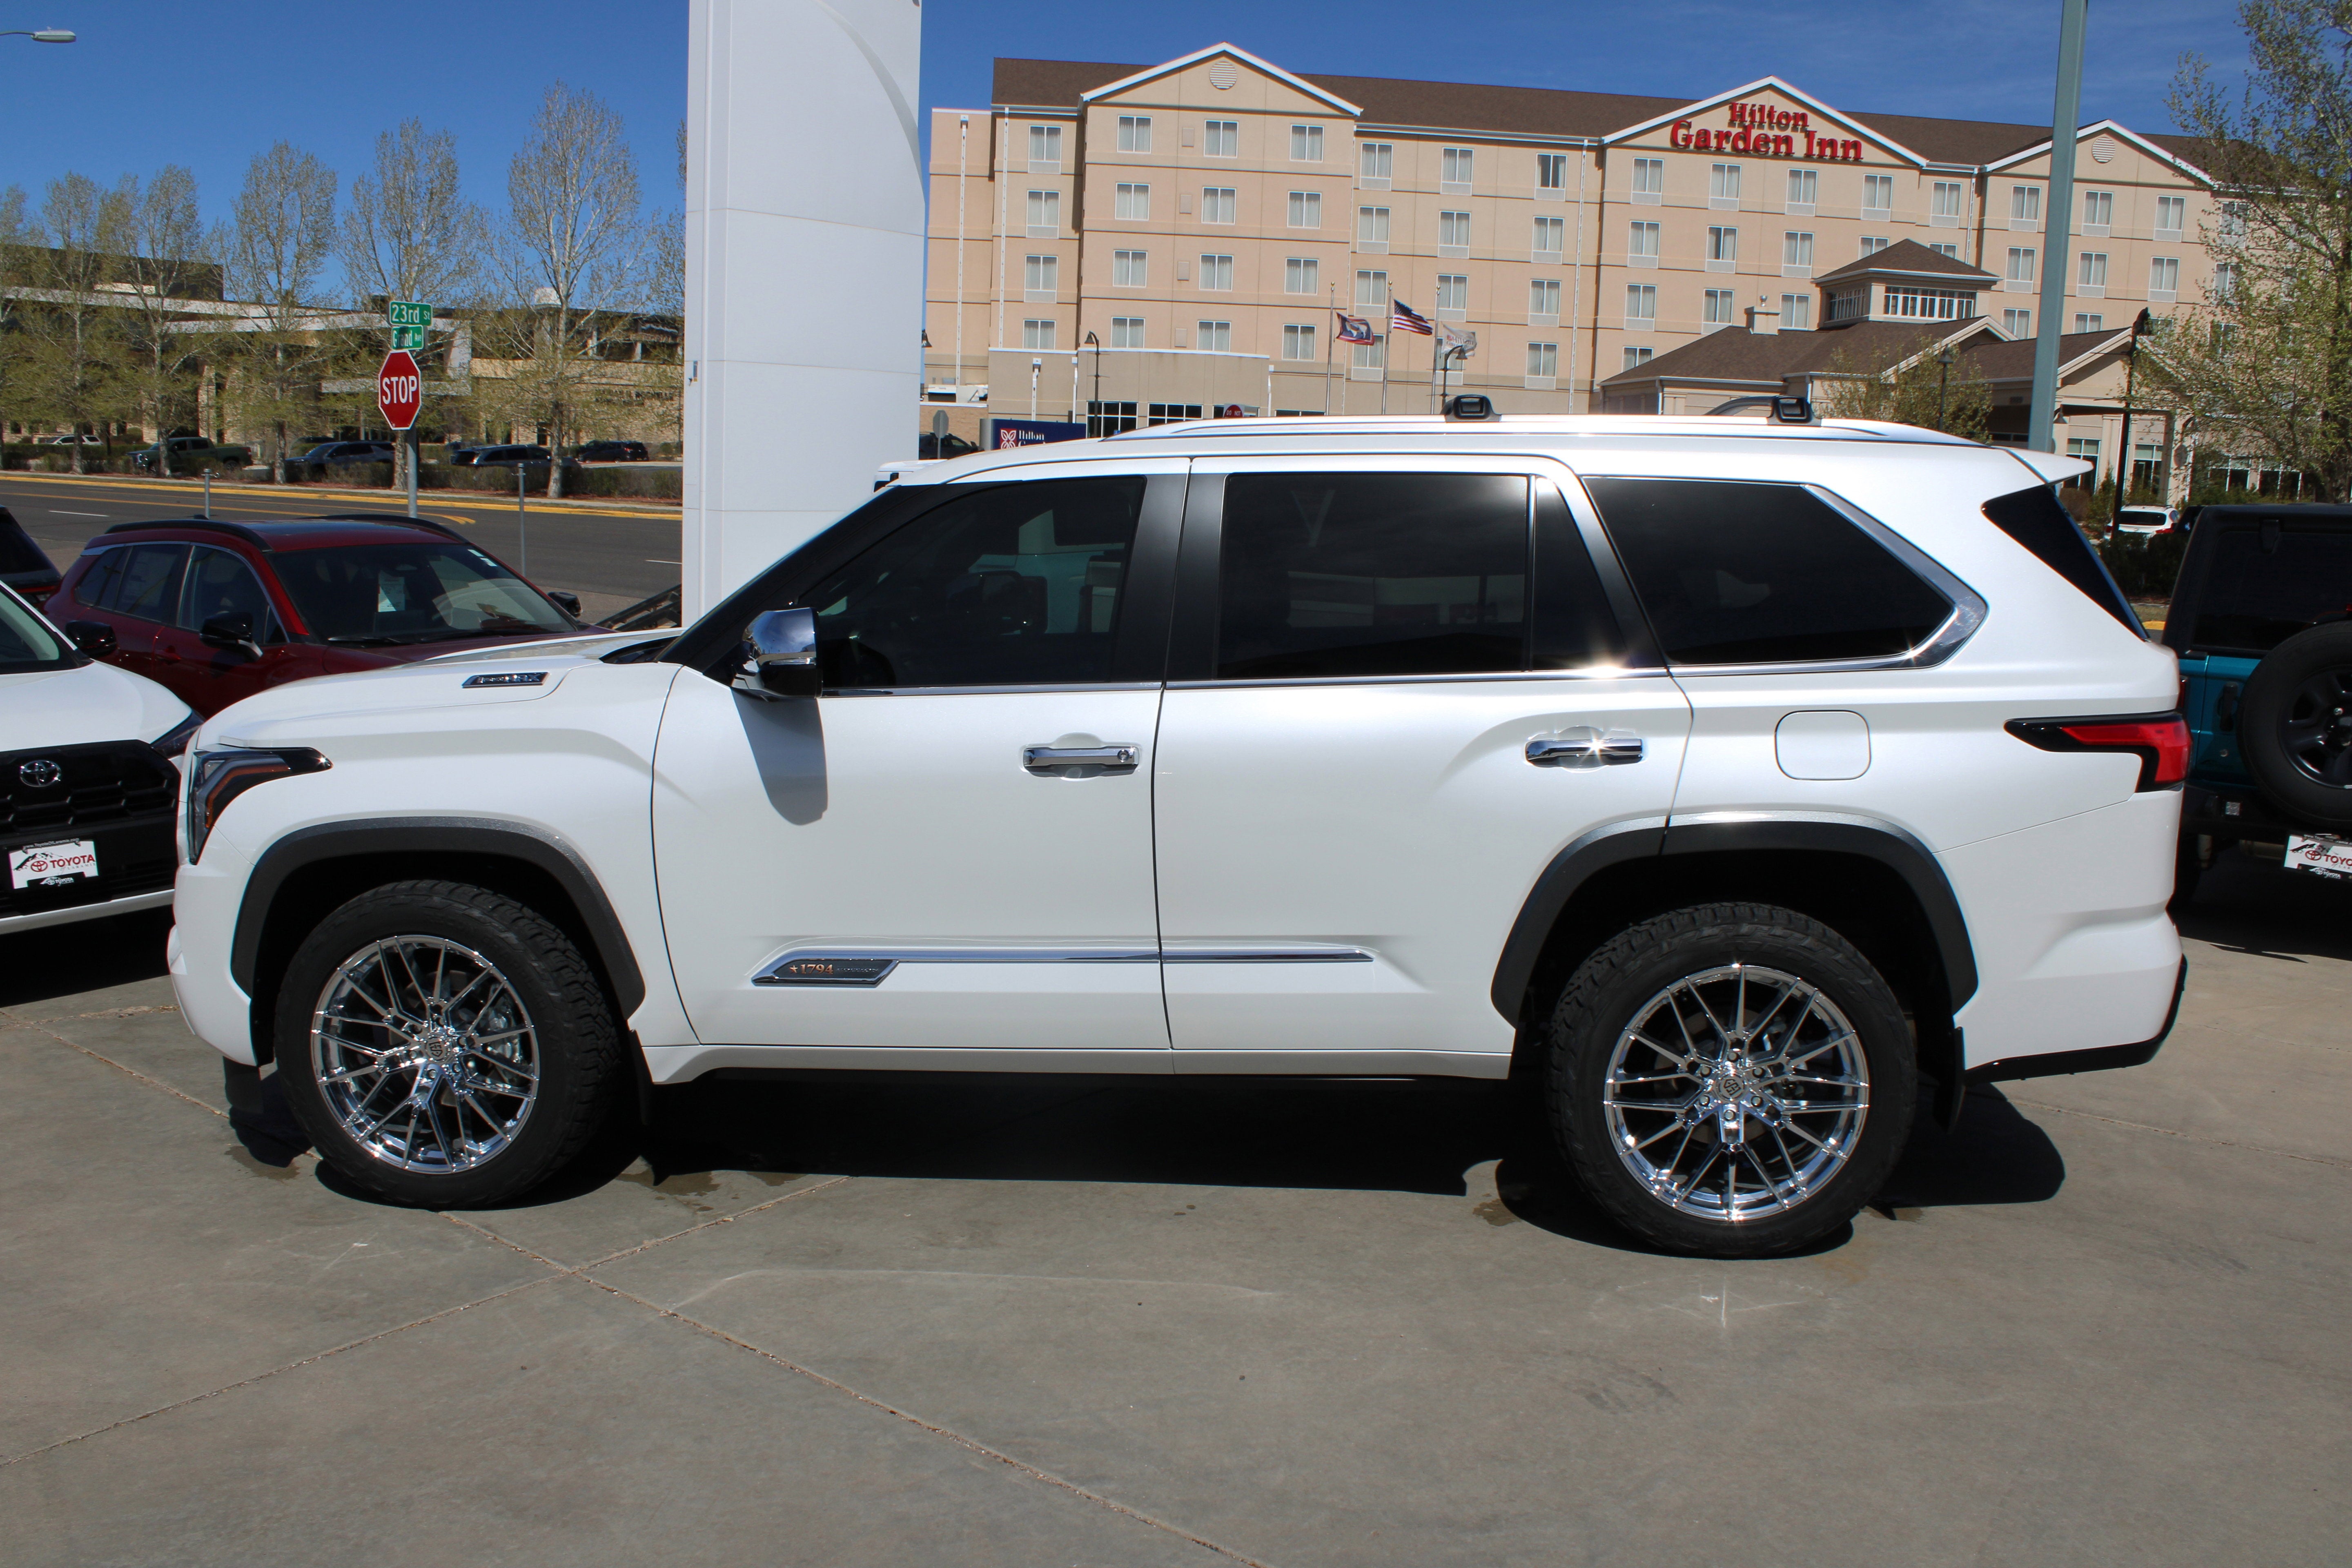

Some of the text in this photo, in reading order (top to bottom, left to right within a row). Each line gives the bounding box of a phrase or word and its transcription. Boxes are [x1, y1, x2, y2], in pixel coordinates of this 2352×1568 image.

[1728, 102, 1809, 128] Hilton
[1671, 119, 1864, 161] Garden Inn
[392, 304, 430, 323] 23rd St
[393, 330, 413, 347] Grand
[382, 375, 418, 405] STOP
[1018, 430, 1045, 441] Hilton
[50, 854, 96, 869] TOYOTA
[800, 964, 833, 974] 1794
